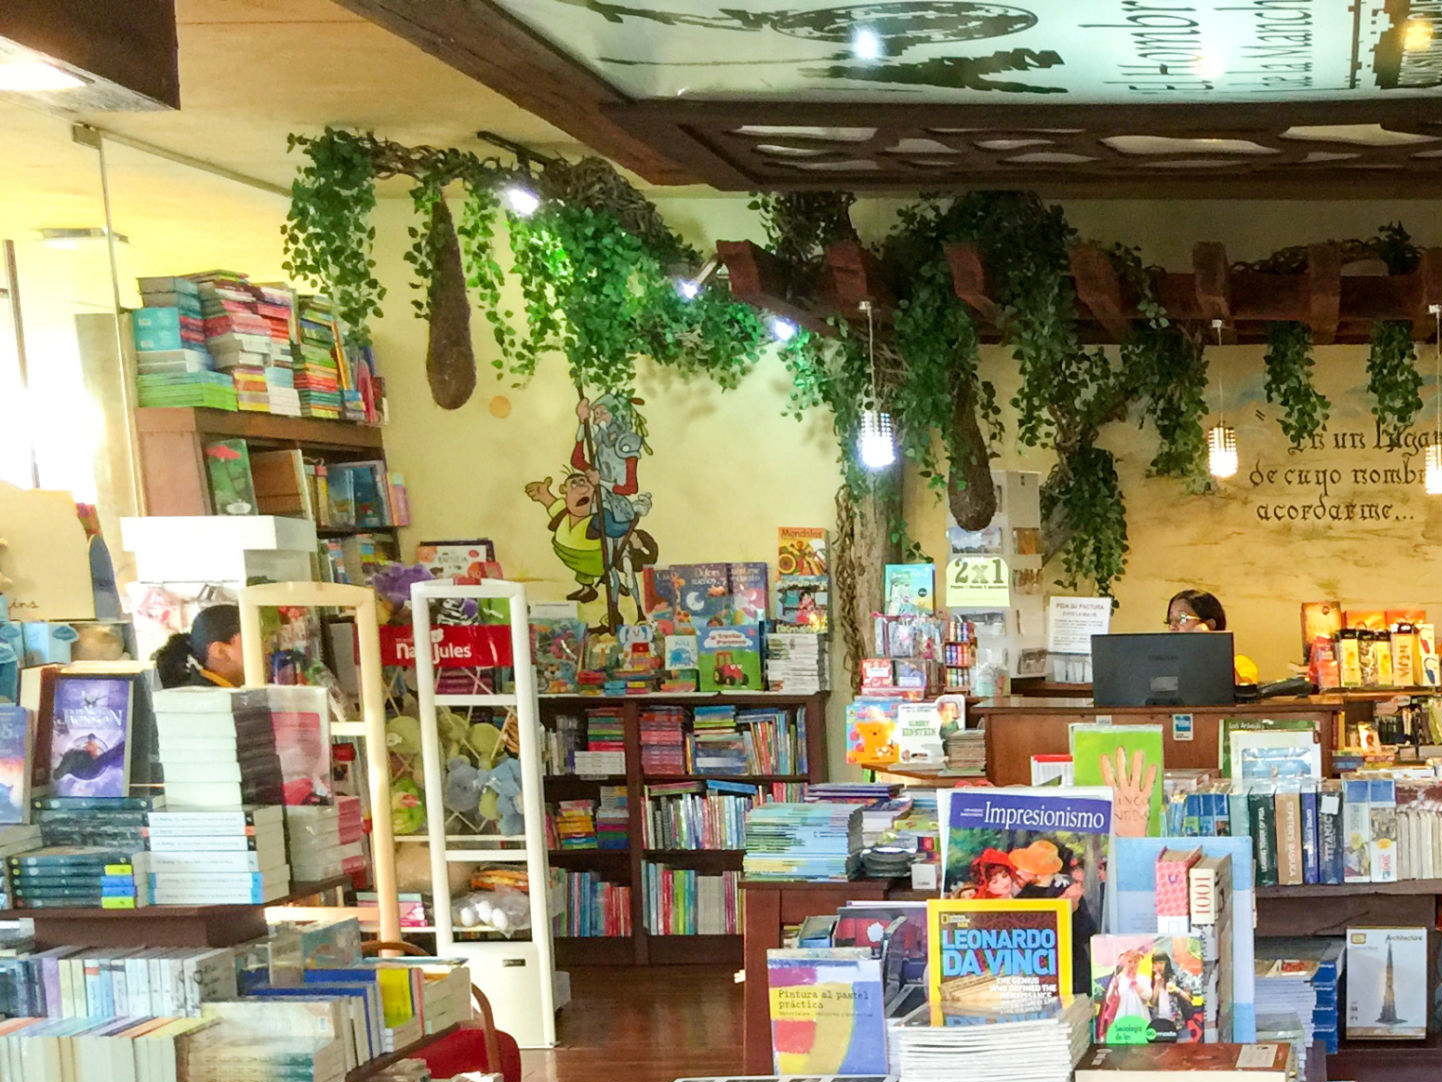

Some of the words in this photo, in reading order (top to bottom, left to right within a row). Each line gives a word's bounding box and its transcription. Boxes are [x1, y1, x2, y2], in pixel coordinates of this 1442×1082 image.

[1078, 0, 1206, 76] Hombr
[1333, 430, 1366, 449] un
[1249, 460, 1276, 488] de
[1352, 459, 1430, 485] nombr
[984, 801, 1105, 829] Impresionismo
[1325, 814, 1334, 861] TITANIC
[1194, 876, 1212, 915] 1001
[942, 929, 1056, 950] LEONARDO
[943, 950, 982, 976] DA
[984, 948, 1057, 976] VINCI
[778, 990, 818, 999] Pintura
[821, 989, 833, 999] al
[836, 991, 869, 1001] pastel
[778, 1001, 824, 1010] práctica
